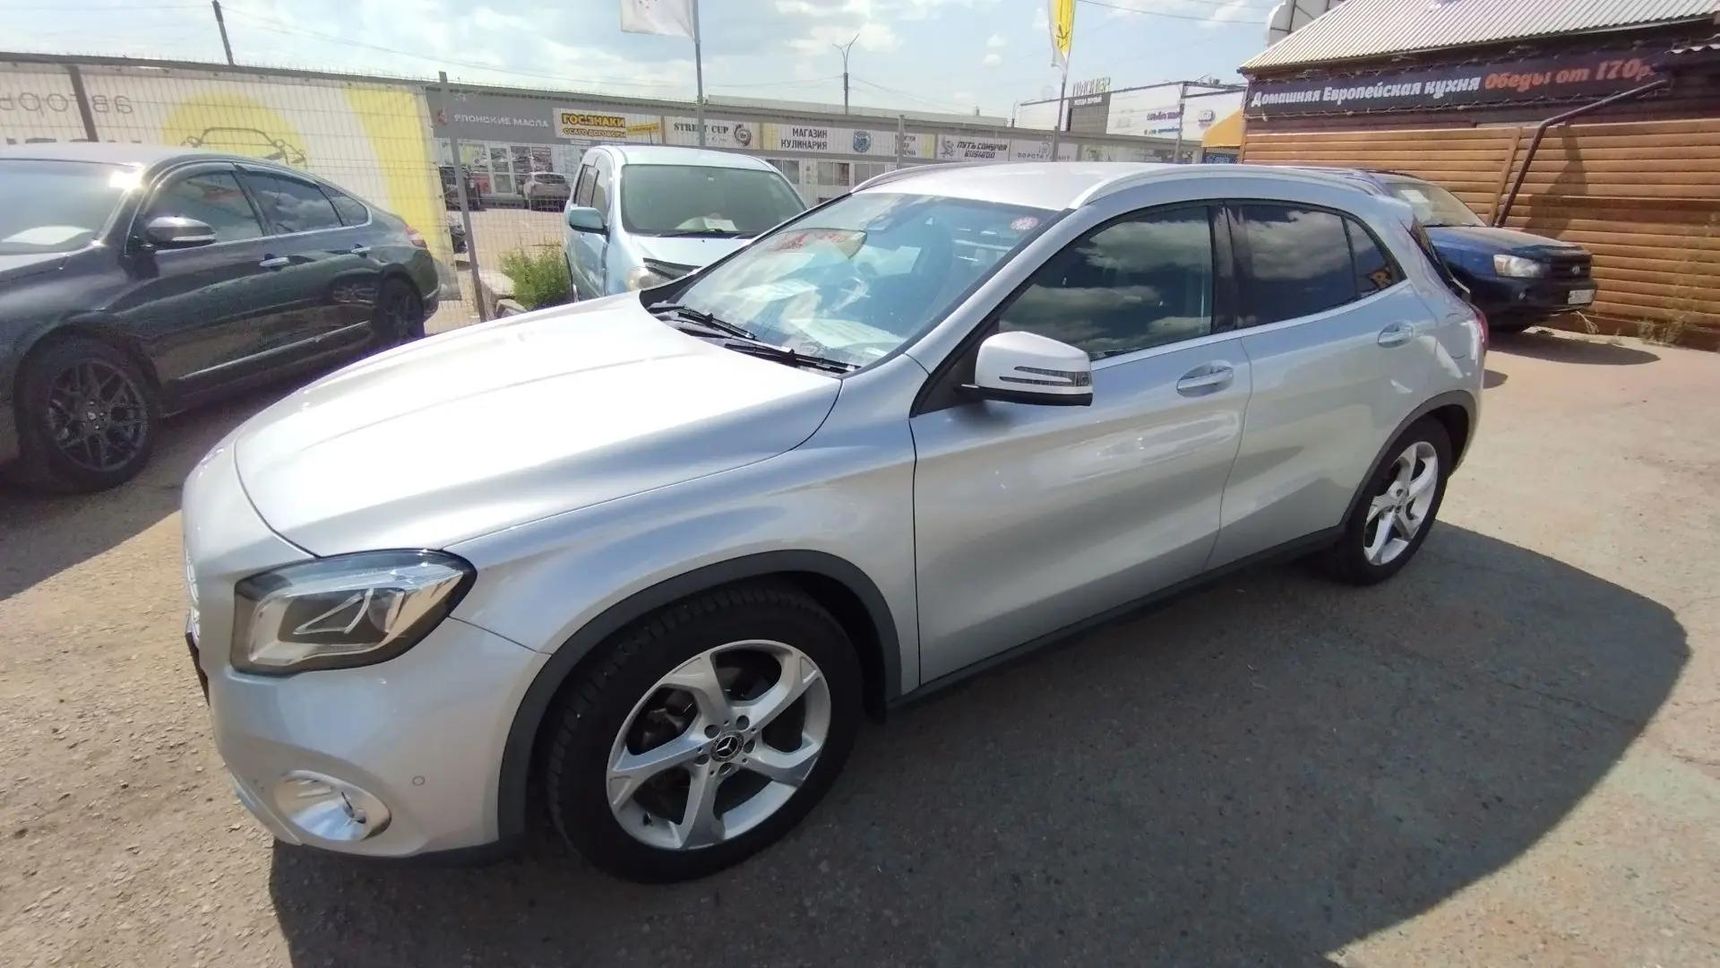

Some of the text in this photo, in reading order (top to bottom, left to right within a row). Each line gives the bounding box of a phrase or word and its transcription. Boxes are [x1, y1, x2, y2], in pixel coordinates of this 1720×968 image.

[1251, 90, 1321, 108] Домашняя
[1323, 81, 1422, 105] Европейская
[1423, 76, 1481, 99] кухня
[1484, 71, 1552, 92] Обеды
[1556, 68, 1590, 84] от
[673, 122, 729, 134] STRET CUP
[792, 128, 828, 139] МАГАЗИН
[780, 138, 828, 150] КУЛИНАРИЯ
